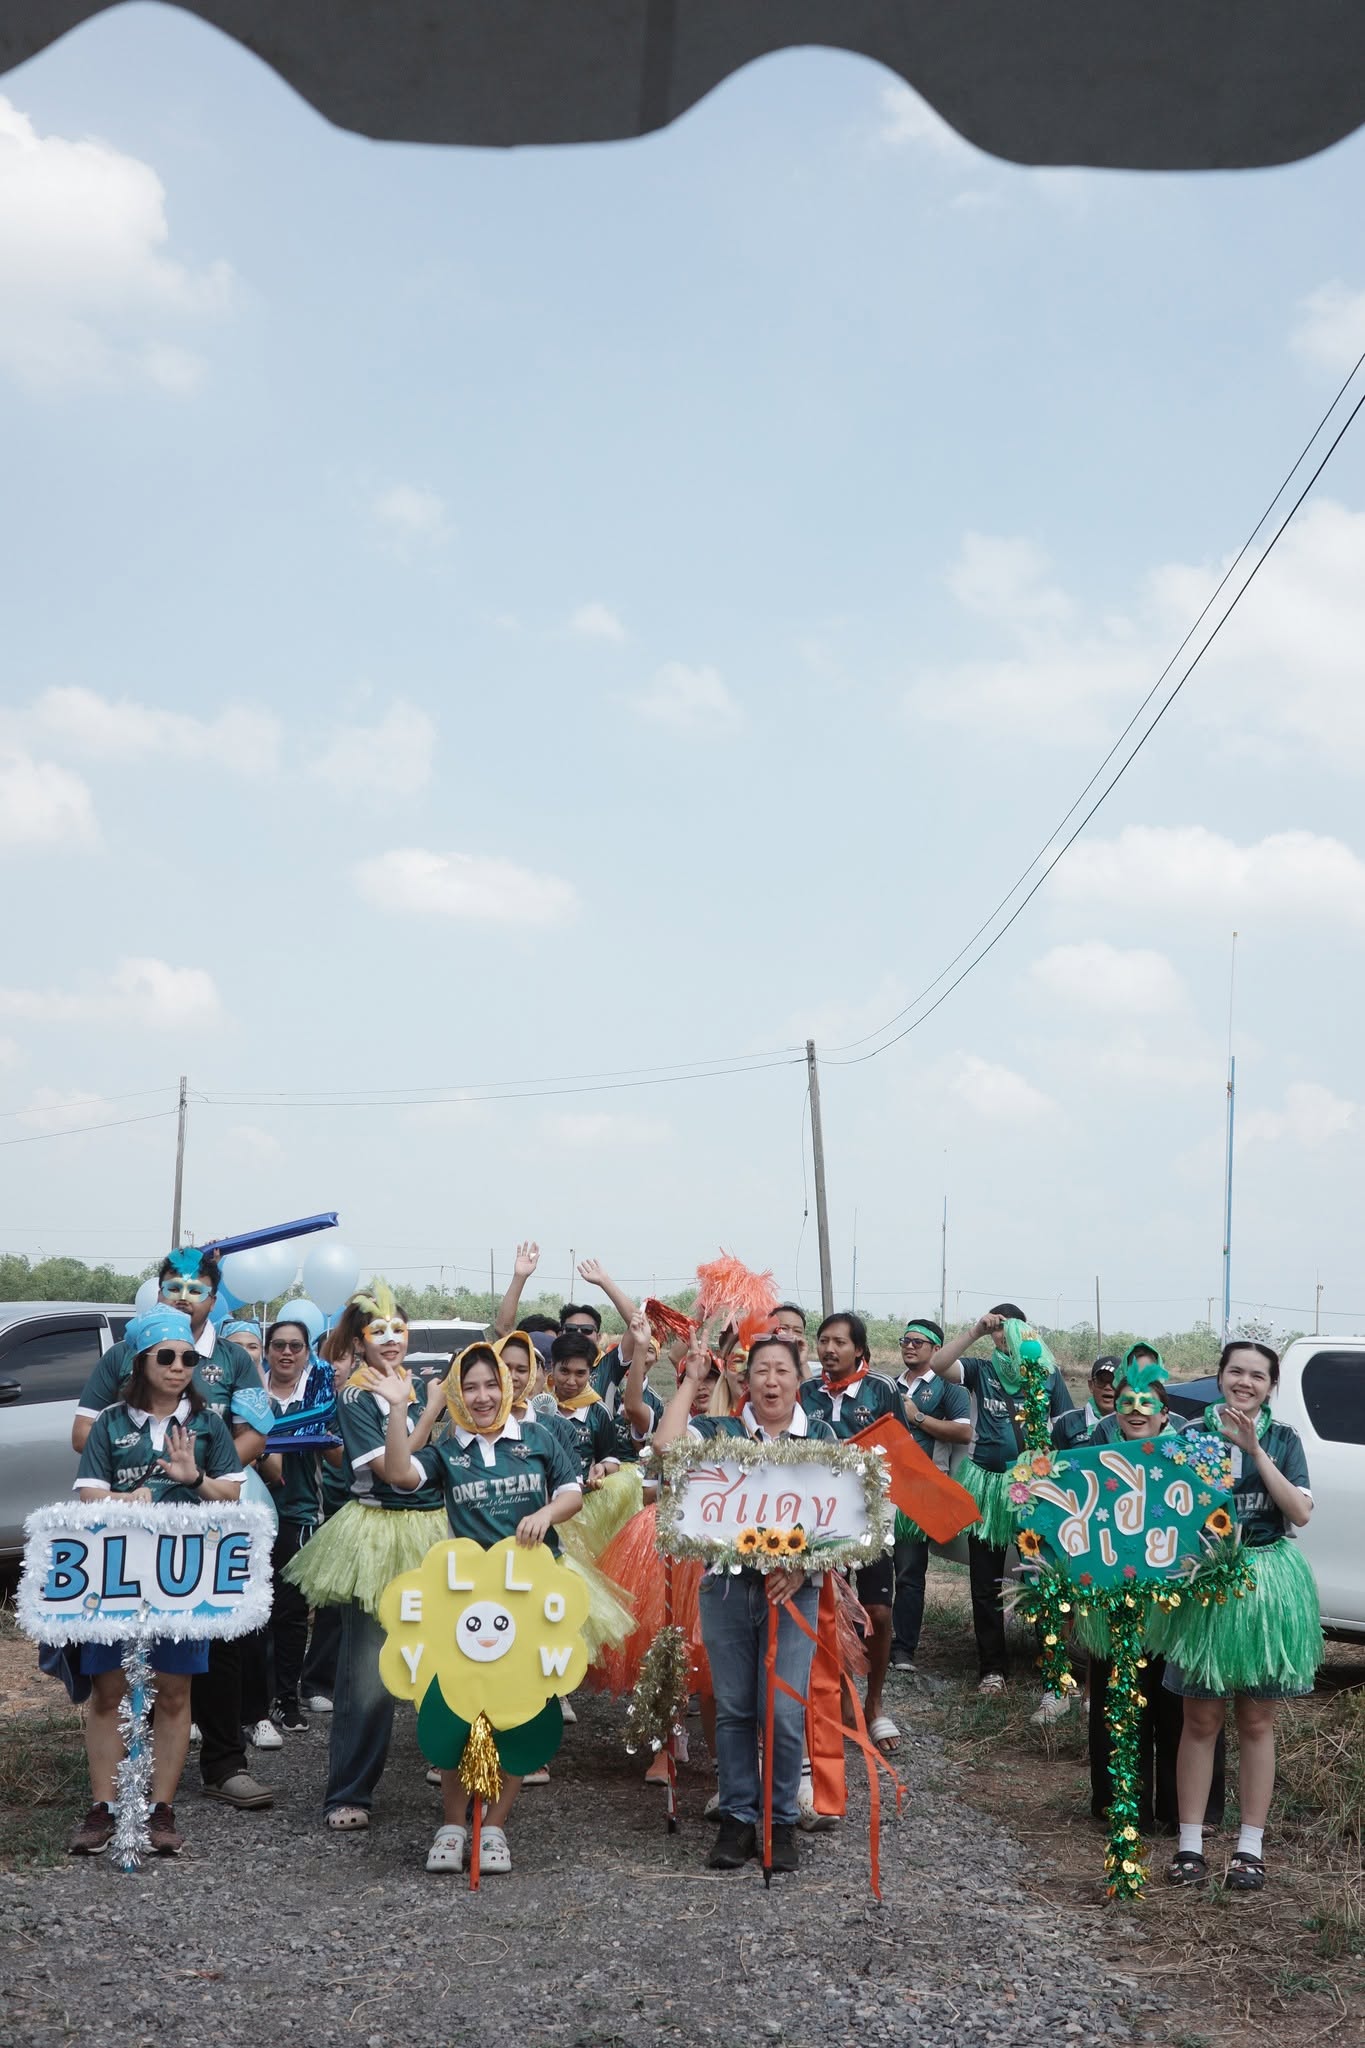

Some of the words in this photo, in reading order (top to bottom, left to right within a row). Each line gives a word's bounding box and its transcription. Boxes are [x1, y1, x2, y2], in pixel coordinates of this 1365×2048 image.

[452, 1480, 489, 1503] ONE
[491, 1473, 542, 1496] TEAM
[41, 1532, 252, 1601] BLUE
